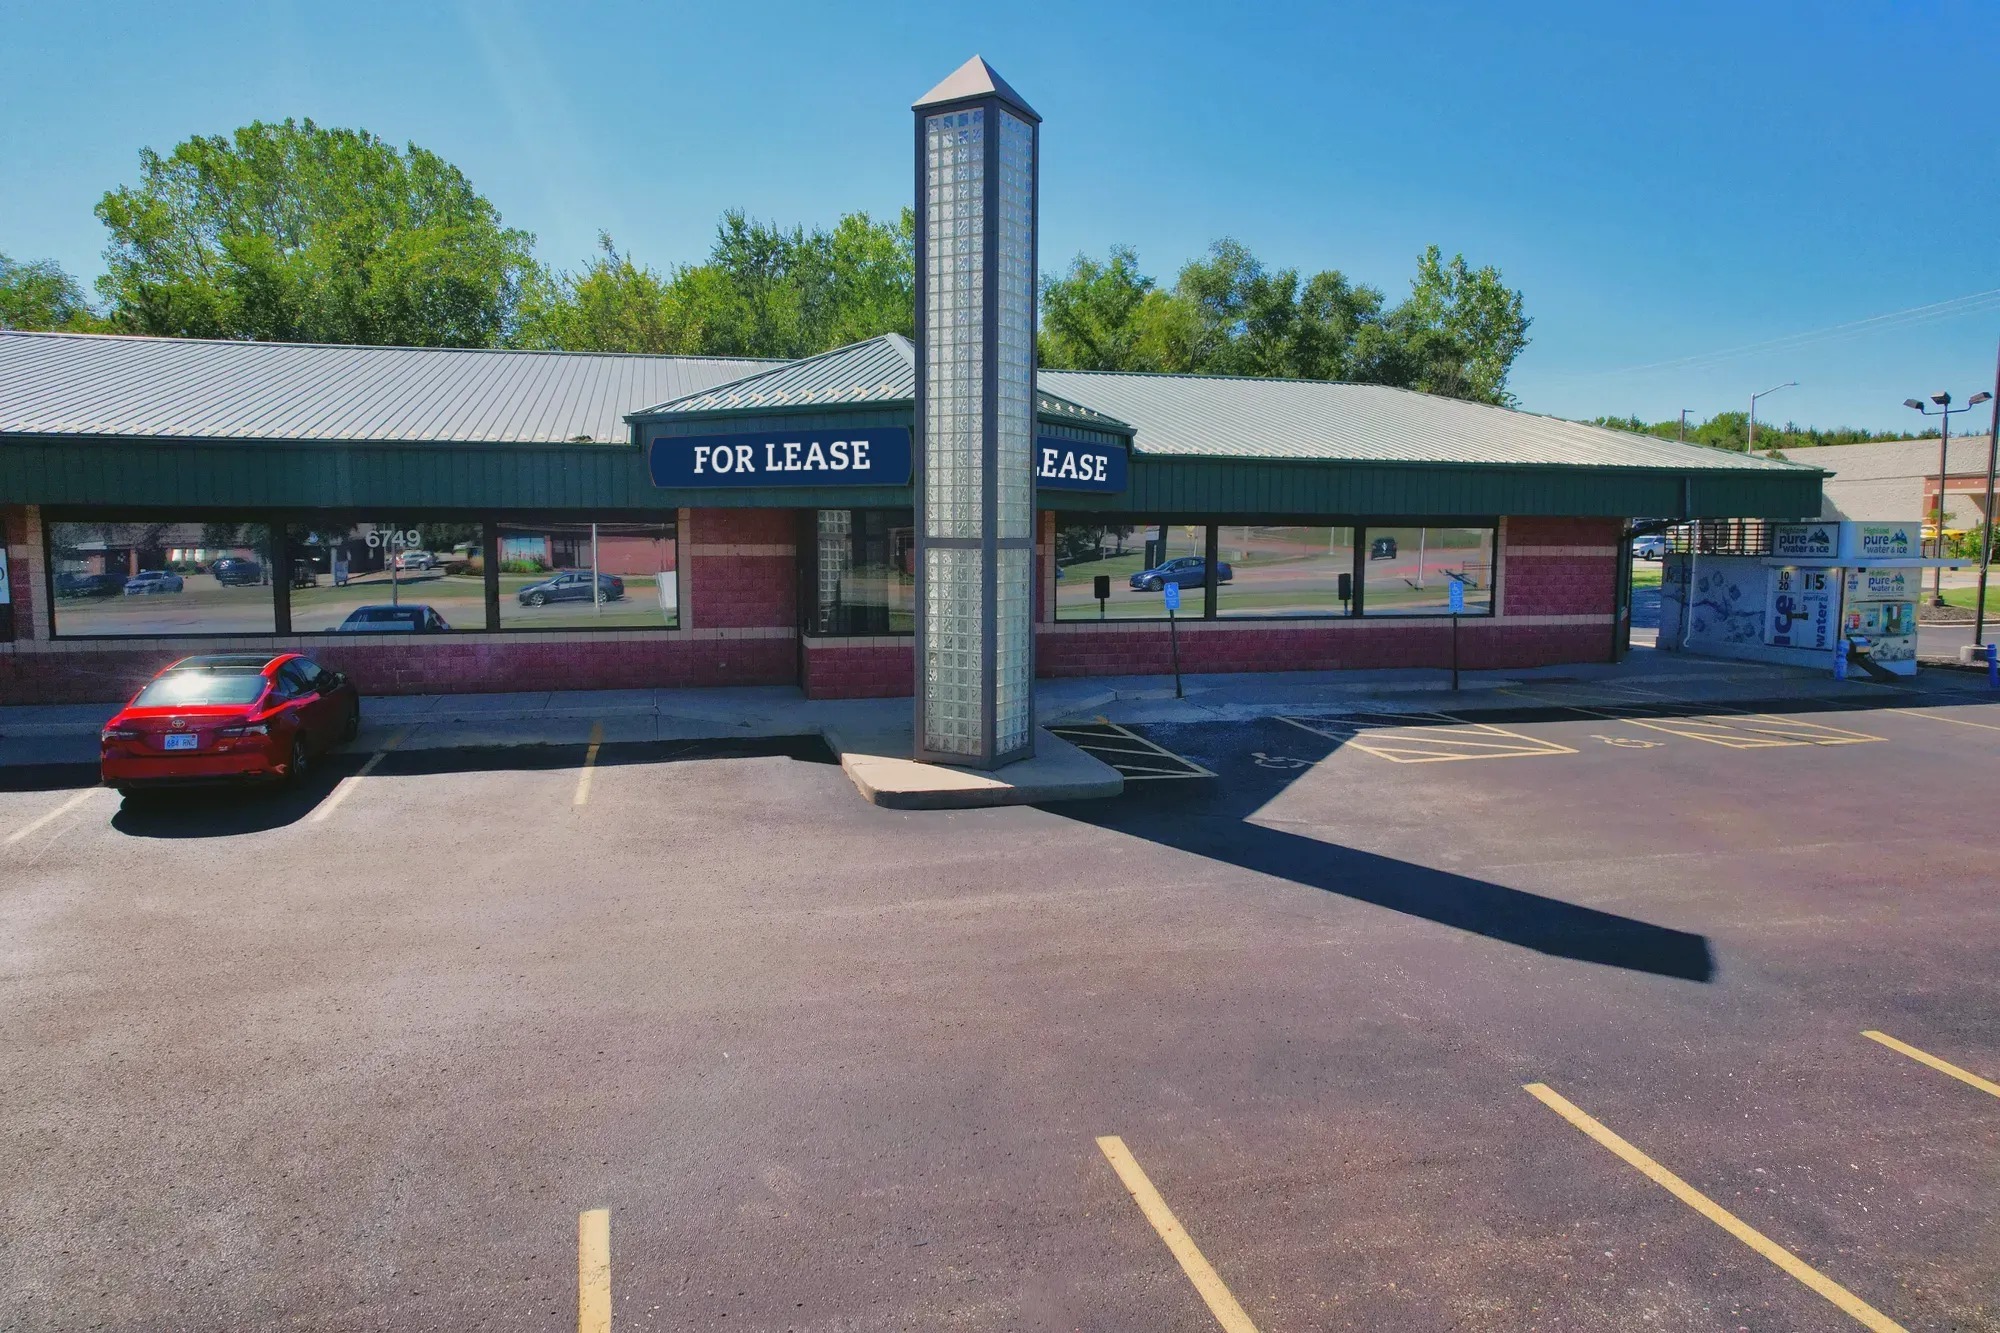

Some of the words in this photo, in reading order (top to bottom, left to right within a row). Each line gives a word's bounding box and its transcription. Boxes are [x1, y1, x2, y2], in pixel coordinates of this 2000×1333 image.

[693, 445, 756, 474] FOR
[765, 440, 871, 472] LEASE
[1036, 447, 1108, 482] EASE
[366, 530, 420, 548] 6749
[1780, 535, 1807, 548] pure
[1864, 535, 1889, 549] pure
[1783, 545, 1808, 553] water
[1867, 545, 1889, 554] water
[1780, 571, 1790, 580] 10
[1778, 581, 1789, 591] 20
[1868, 577, 1890, 588] pure
[1871, 584, 1891, 592] water
[1815, 601, 1828, 648] water
[167, 739, 179, 747] 684
